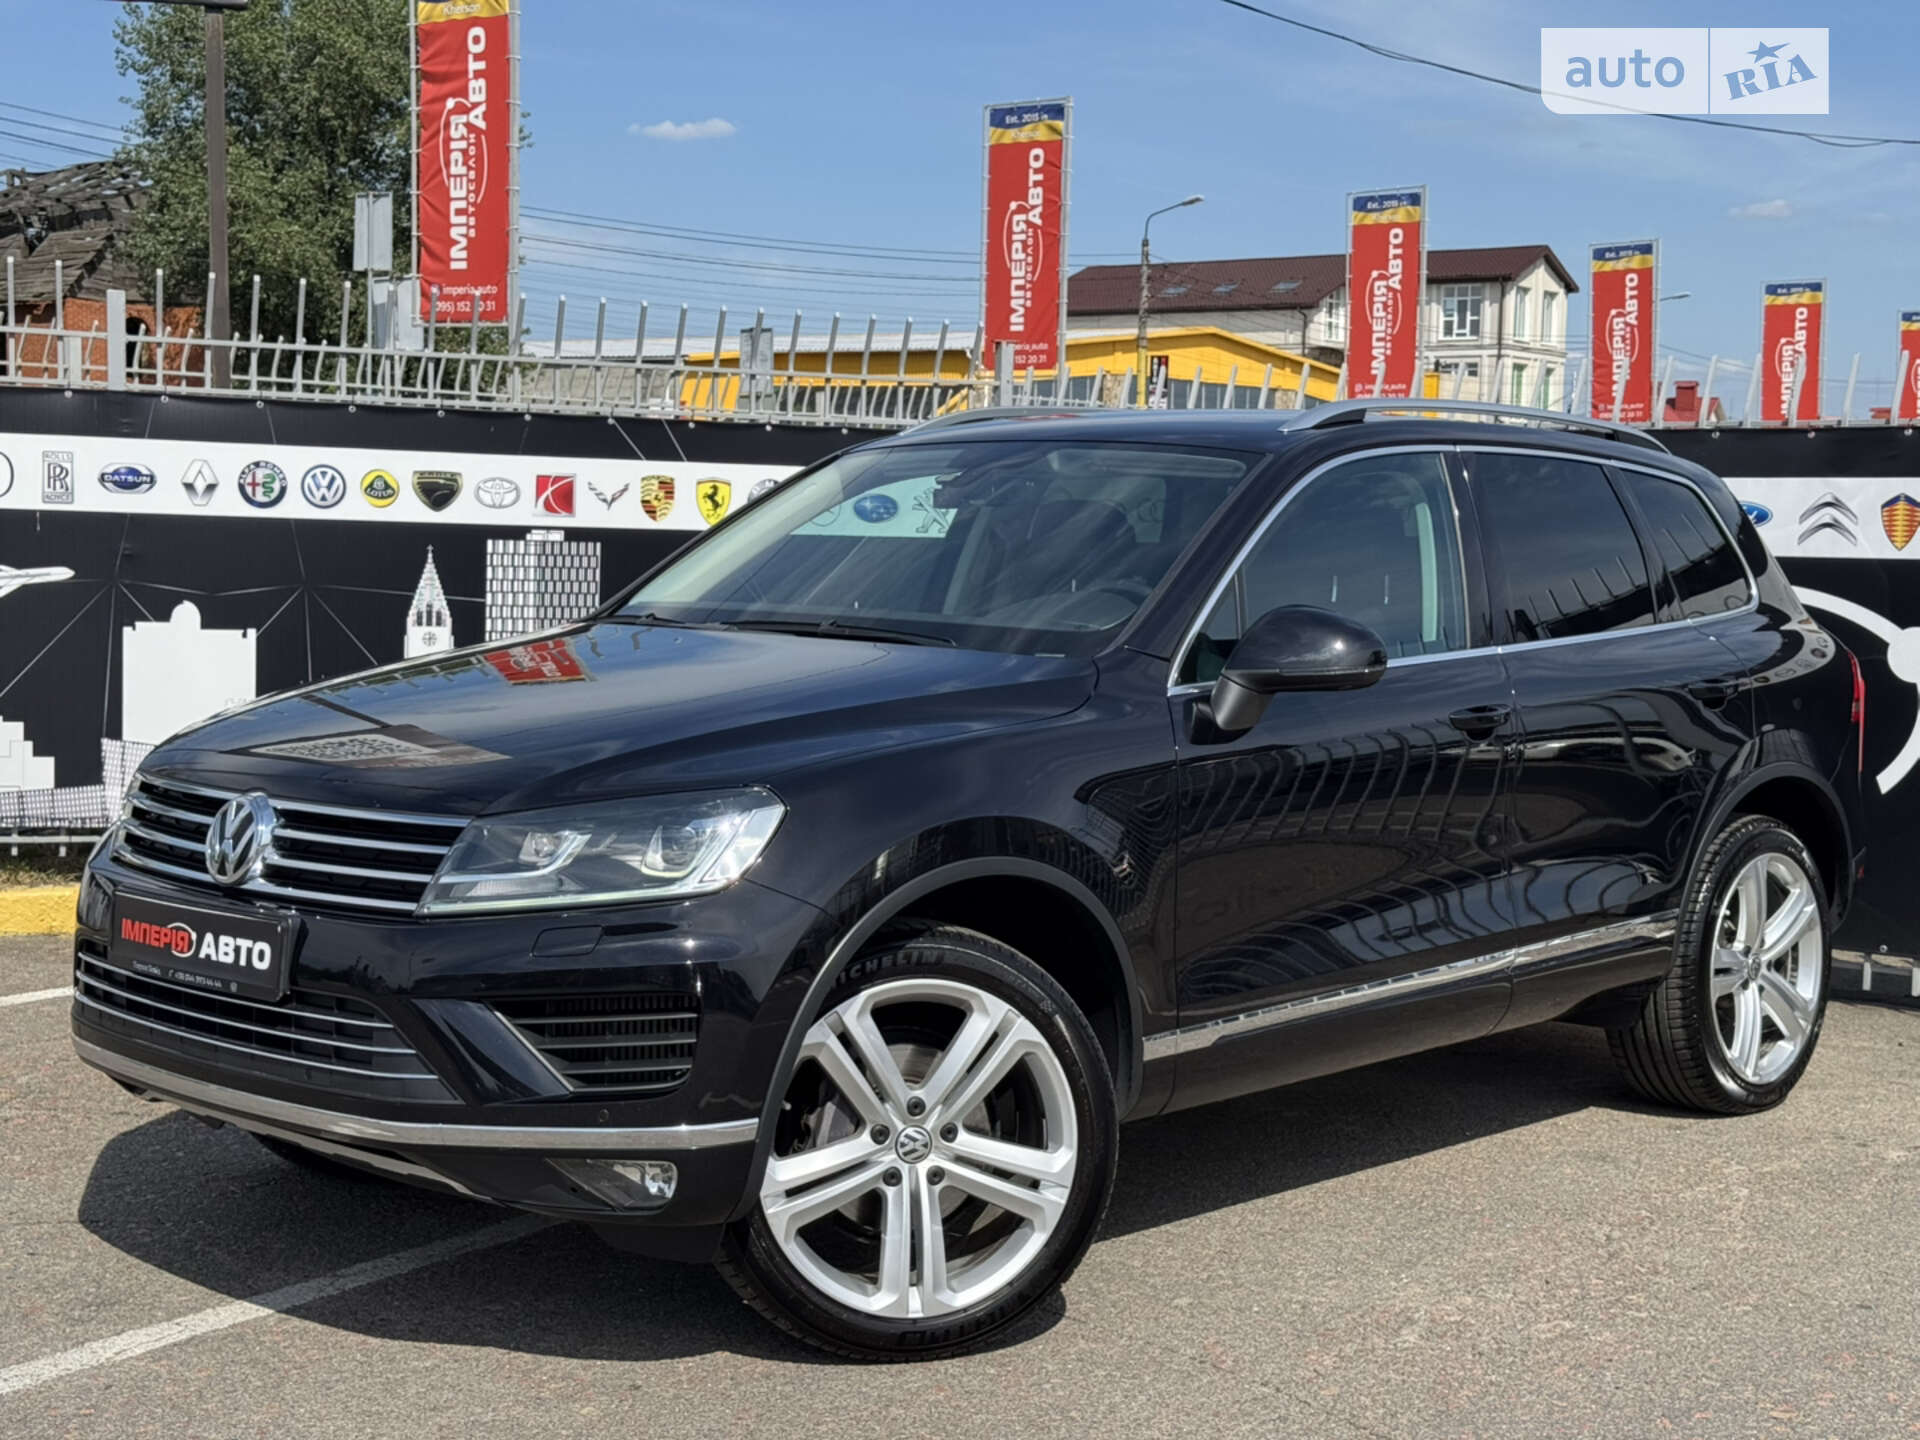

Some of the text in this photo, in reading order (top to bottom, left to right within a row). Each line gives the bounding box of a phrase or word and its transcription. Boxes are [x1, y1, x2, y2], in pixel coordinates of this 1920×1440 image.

[467, 26, 487, 130] АВТО
[450, 114, 468, 270] ІМПЕРІЯ
[1028, 147, 1045, 226] АВТО
[1010, 213, 1027, 332] ІМПЕРІЯ
[1389, 228, 1404, 290] АВТО
[456, 300, 472, 312] 152
[1625, 273, 1639, 326] АВТО
[1794, 307, 1808, 352] АВТО
[104, 475, 151, 483] DATSUN
[367, 488, 393, 498] LOTUS
[121, 917, 190, 953] ІМПЕРІЯ
[198, 932, 271, 970] АВТО
